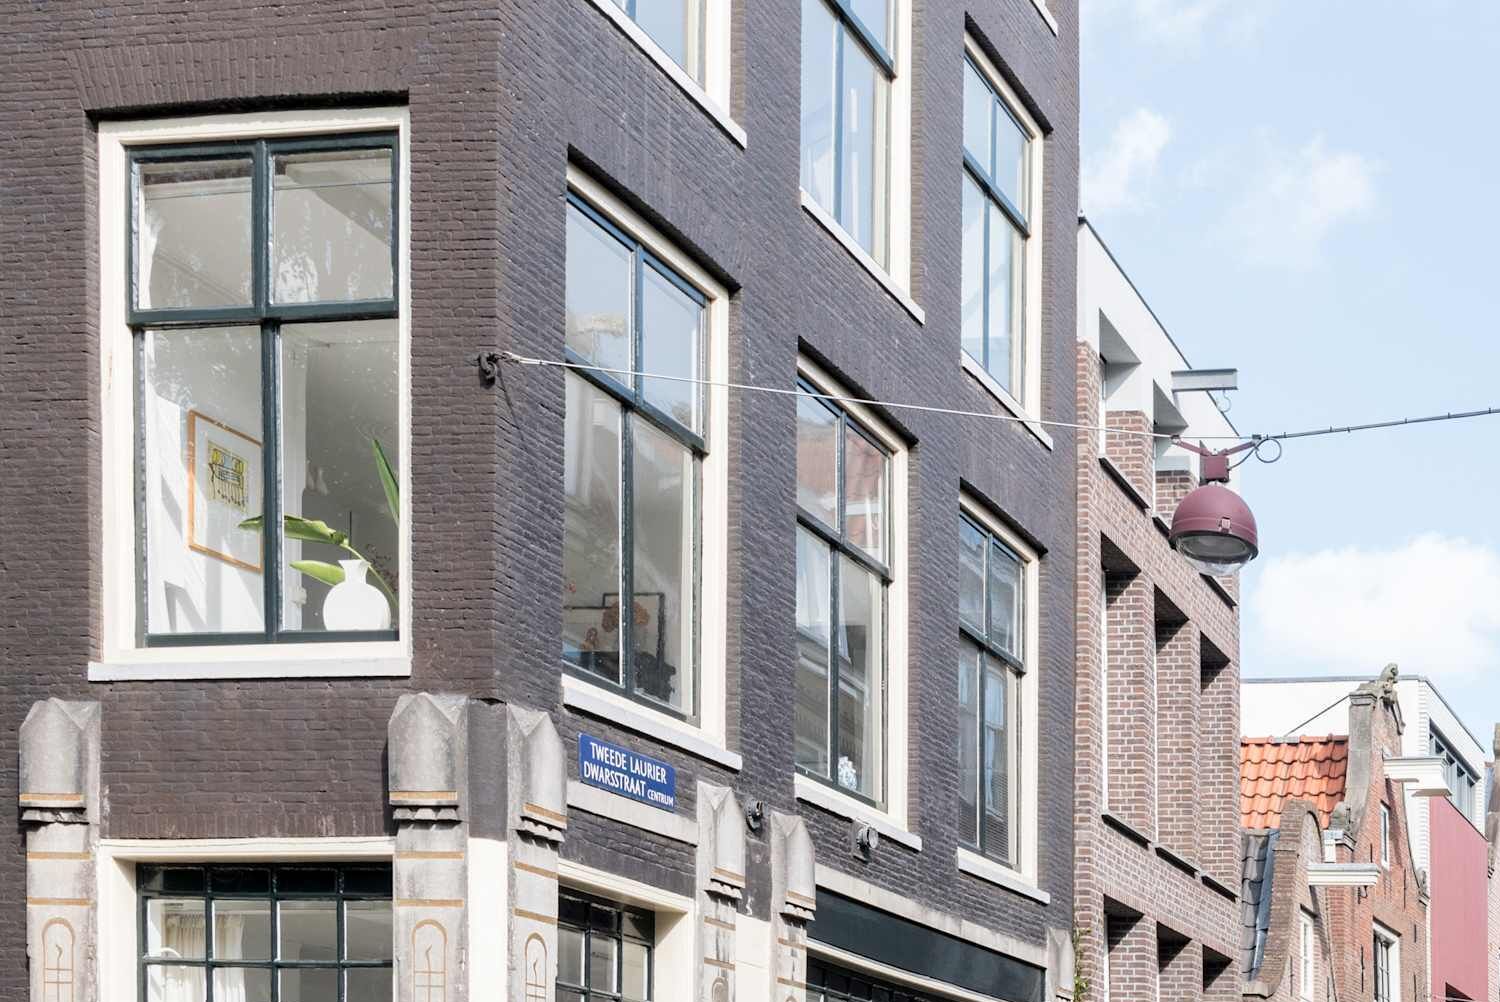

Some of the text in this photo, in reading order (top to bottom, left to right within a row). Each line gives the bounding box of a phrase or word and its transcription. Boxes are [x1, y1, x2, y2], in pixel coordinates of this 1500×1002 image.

[584, 761, 674, 807] DWARSSTRAAT CENTRUM
[590, 742, 667, 784] TWEEDE LAURIER
